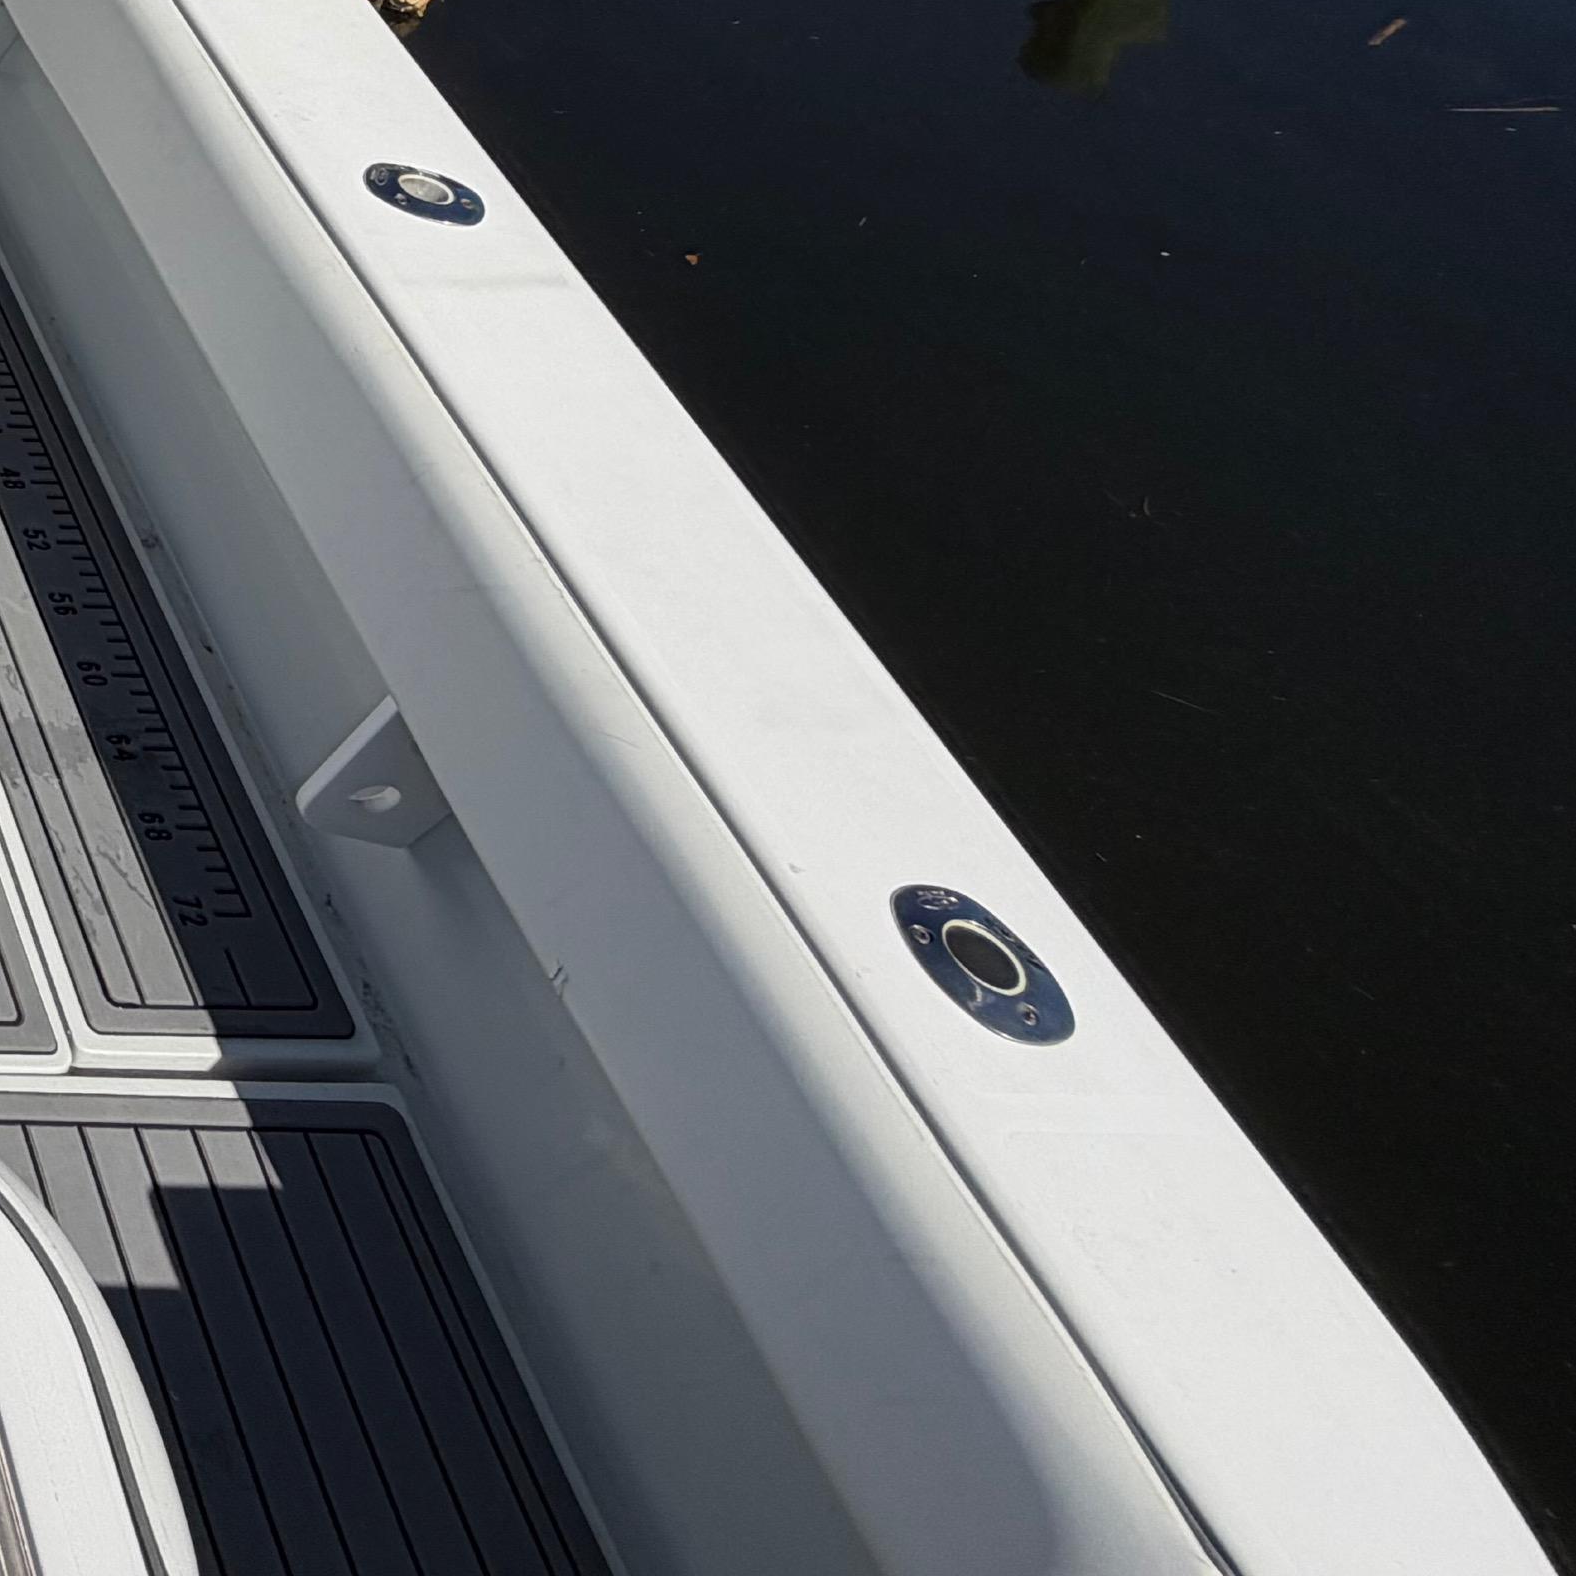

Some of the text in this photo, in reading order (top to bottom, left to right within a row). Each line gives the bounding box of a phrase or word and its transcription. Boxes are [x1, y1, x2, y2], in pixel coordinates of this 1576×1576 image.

[0, 467, 25, 489] 48
[22, 528, 51, 551] 52
[48, 592, 78, 616] 56
[76, 661, 108, 687] 60
[105, 734, 138, 761] 64
[137, 812, 173, 841] 68
[173, 896, 208, 927] 72
